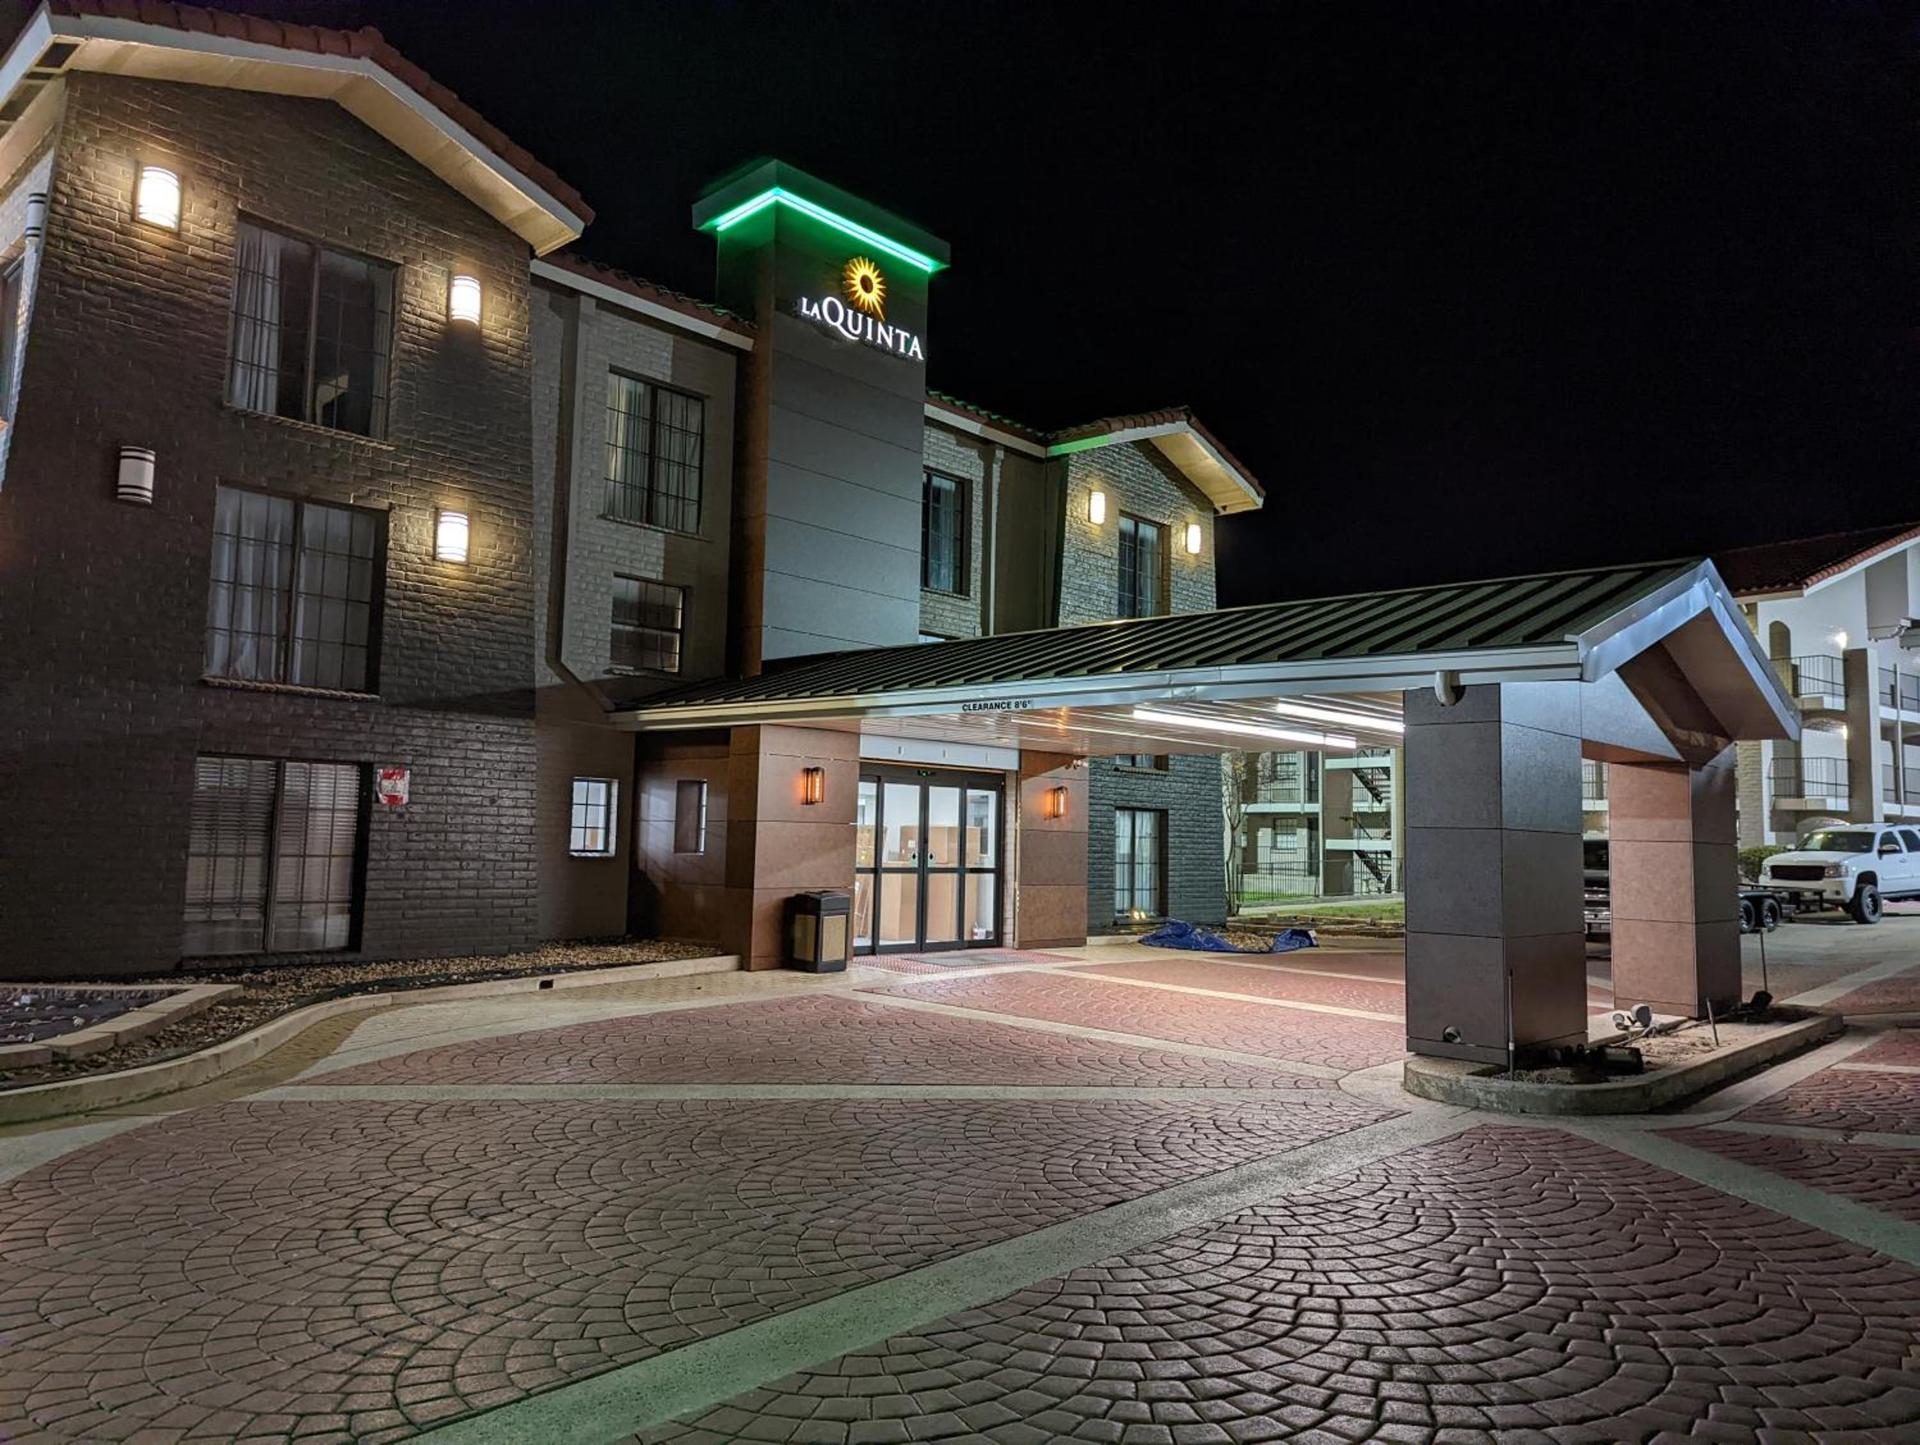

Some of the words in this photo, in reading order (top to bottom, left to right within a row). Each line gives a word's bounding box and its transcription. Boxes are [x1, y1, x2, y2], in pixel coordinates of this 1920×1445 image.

[801, 296, 822, 321] LA
[821, 296, 924, 361] QUINTA
[961, 701, 1012, 712] CLEARANCE
